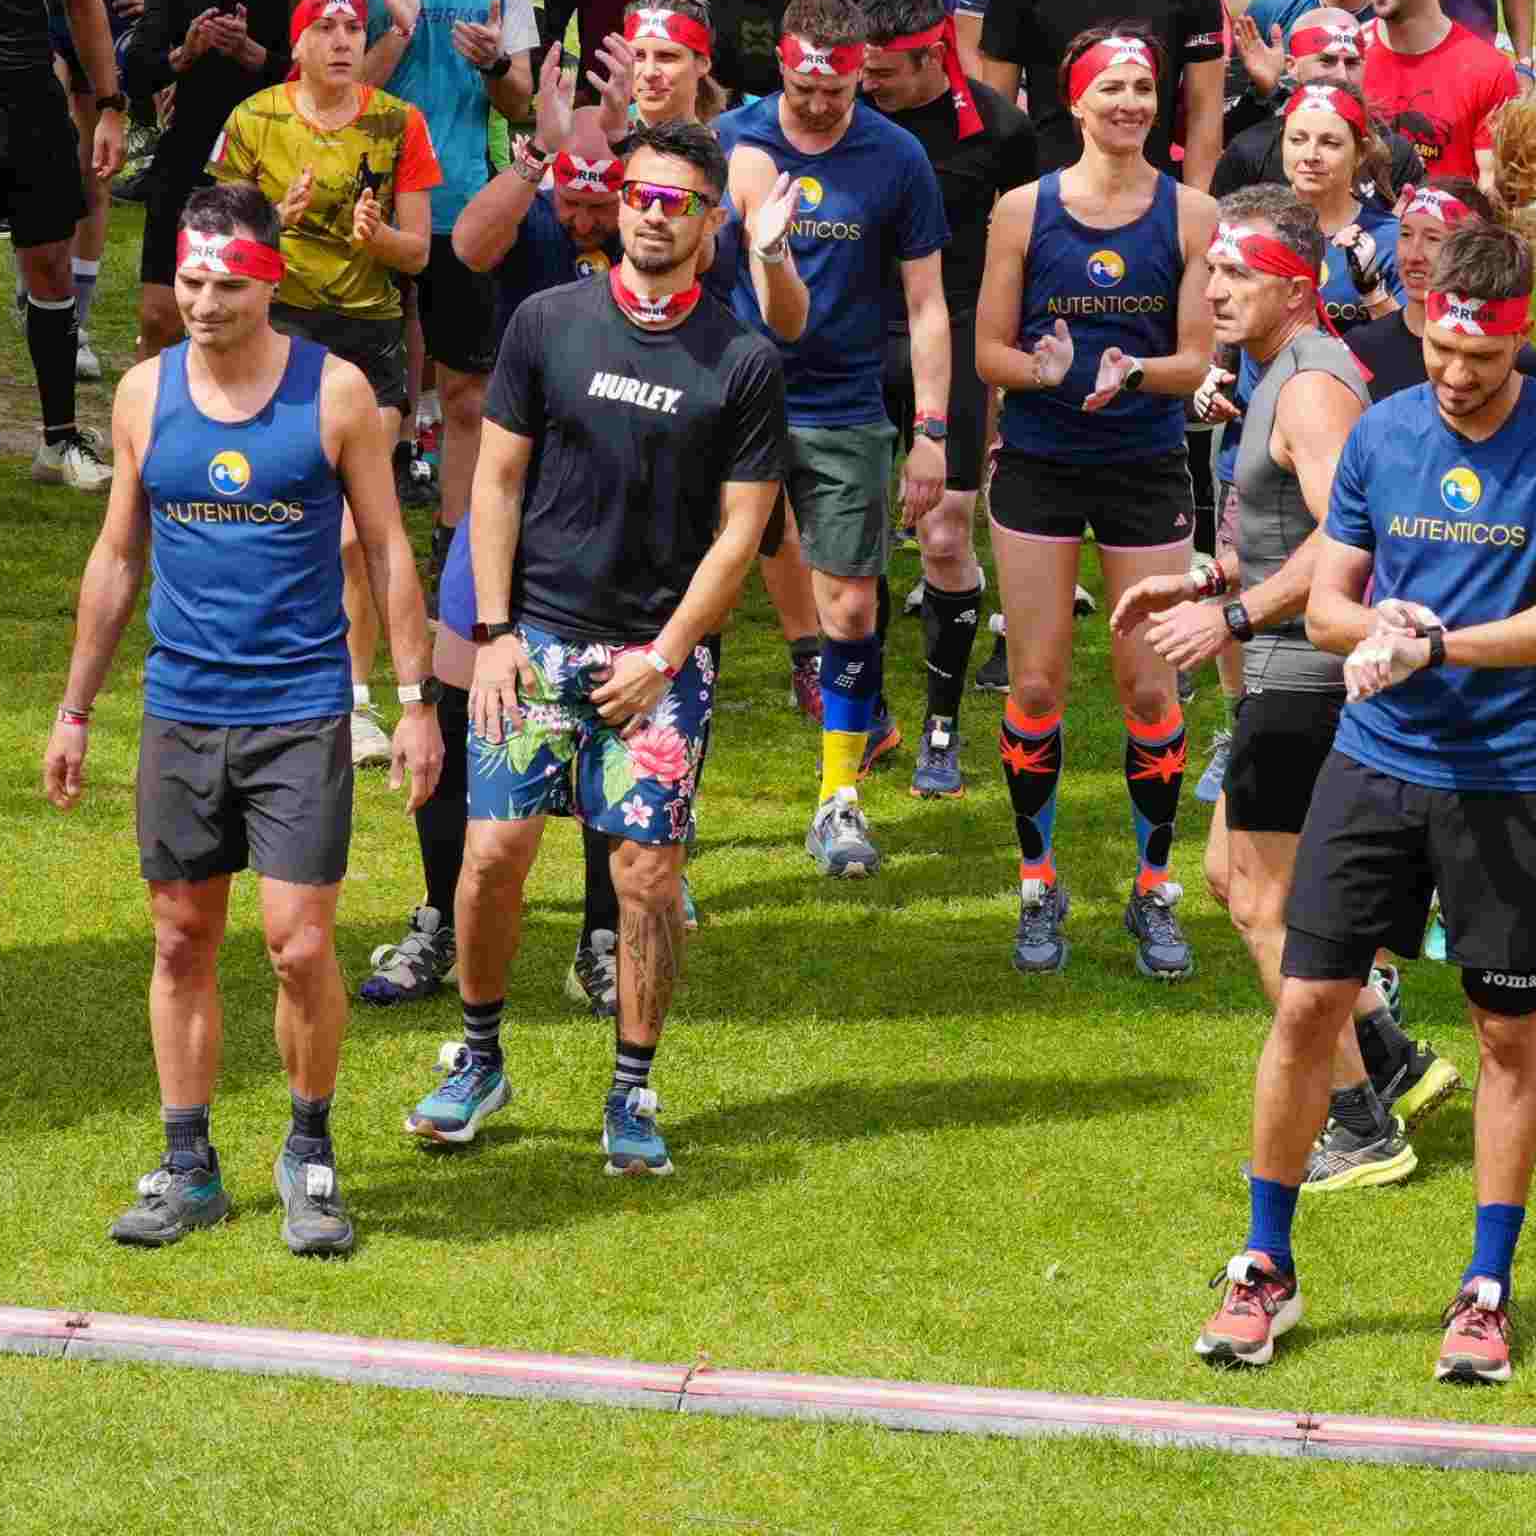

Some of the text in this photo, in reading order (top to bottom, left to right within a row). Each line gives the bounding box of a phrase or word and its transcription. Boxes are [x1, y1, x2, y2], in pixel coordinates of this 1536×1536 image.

[1046, 294, 1165, 315] AUTENTICOS
[166, 500, 304, 524] AUTENTICOS
[1388, 515, 1526, 548] AUTENTICOS
